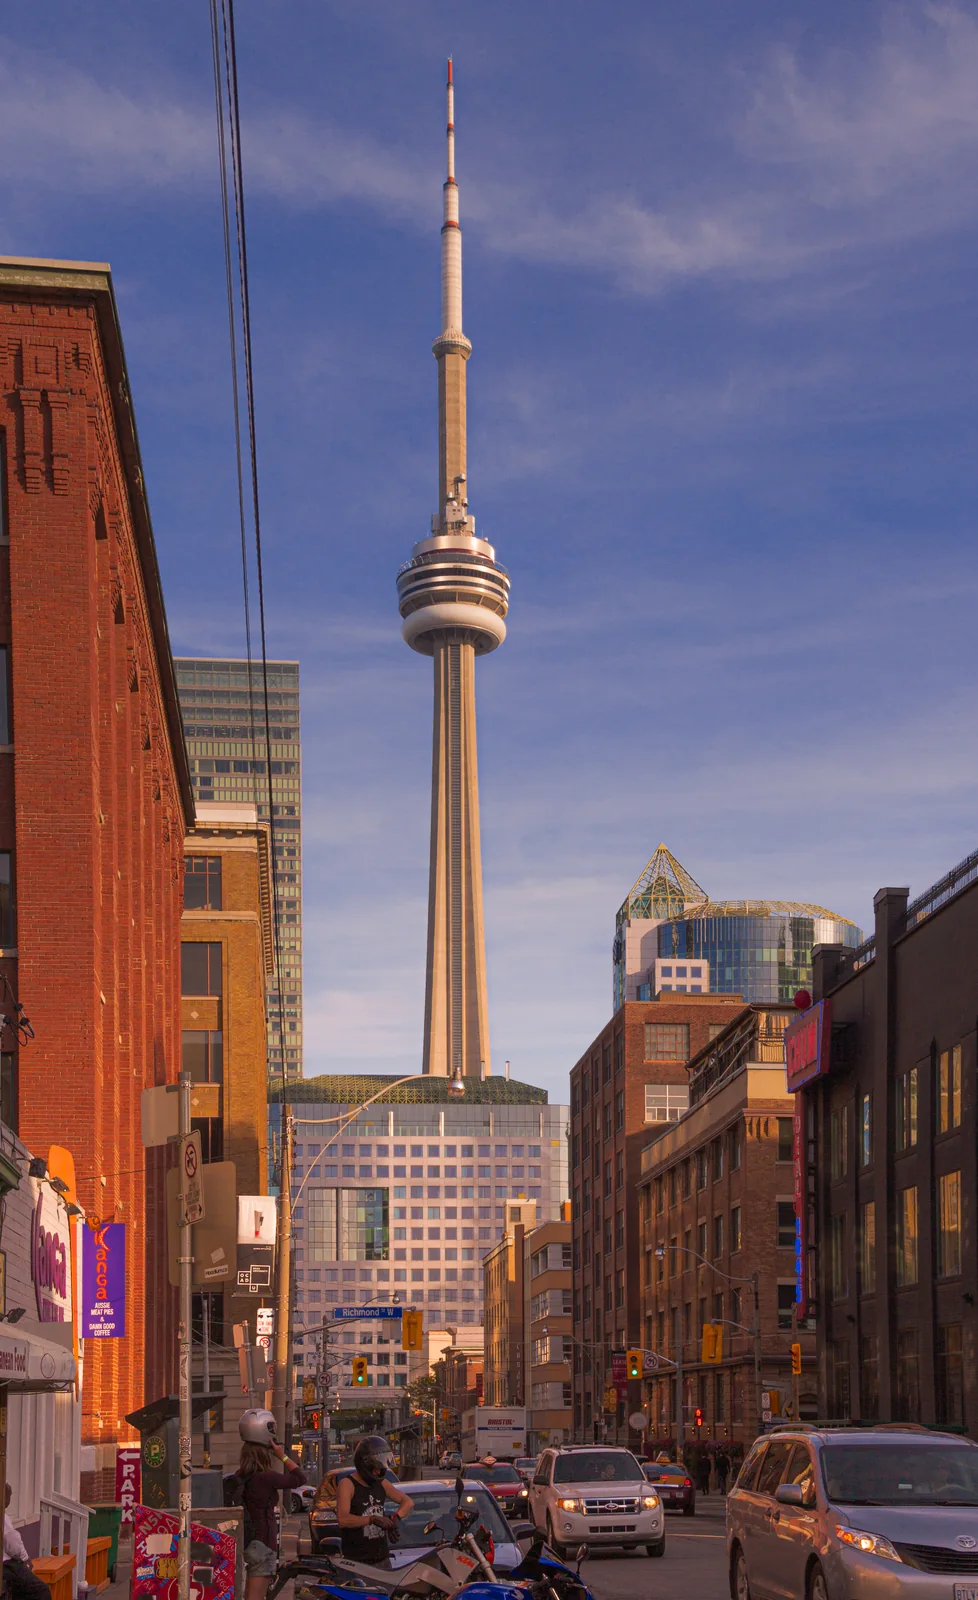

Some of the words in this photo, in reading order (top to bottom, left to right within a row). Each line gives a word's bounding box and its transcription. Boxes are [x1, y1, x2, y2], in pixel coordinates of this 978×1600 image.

[342, 1308, 380, 1316] Richmond
[387, 1308, 394, 1316] W
[456, 1555, 474, 1568] KTM
